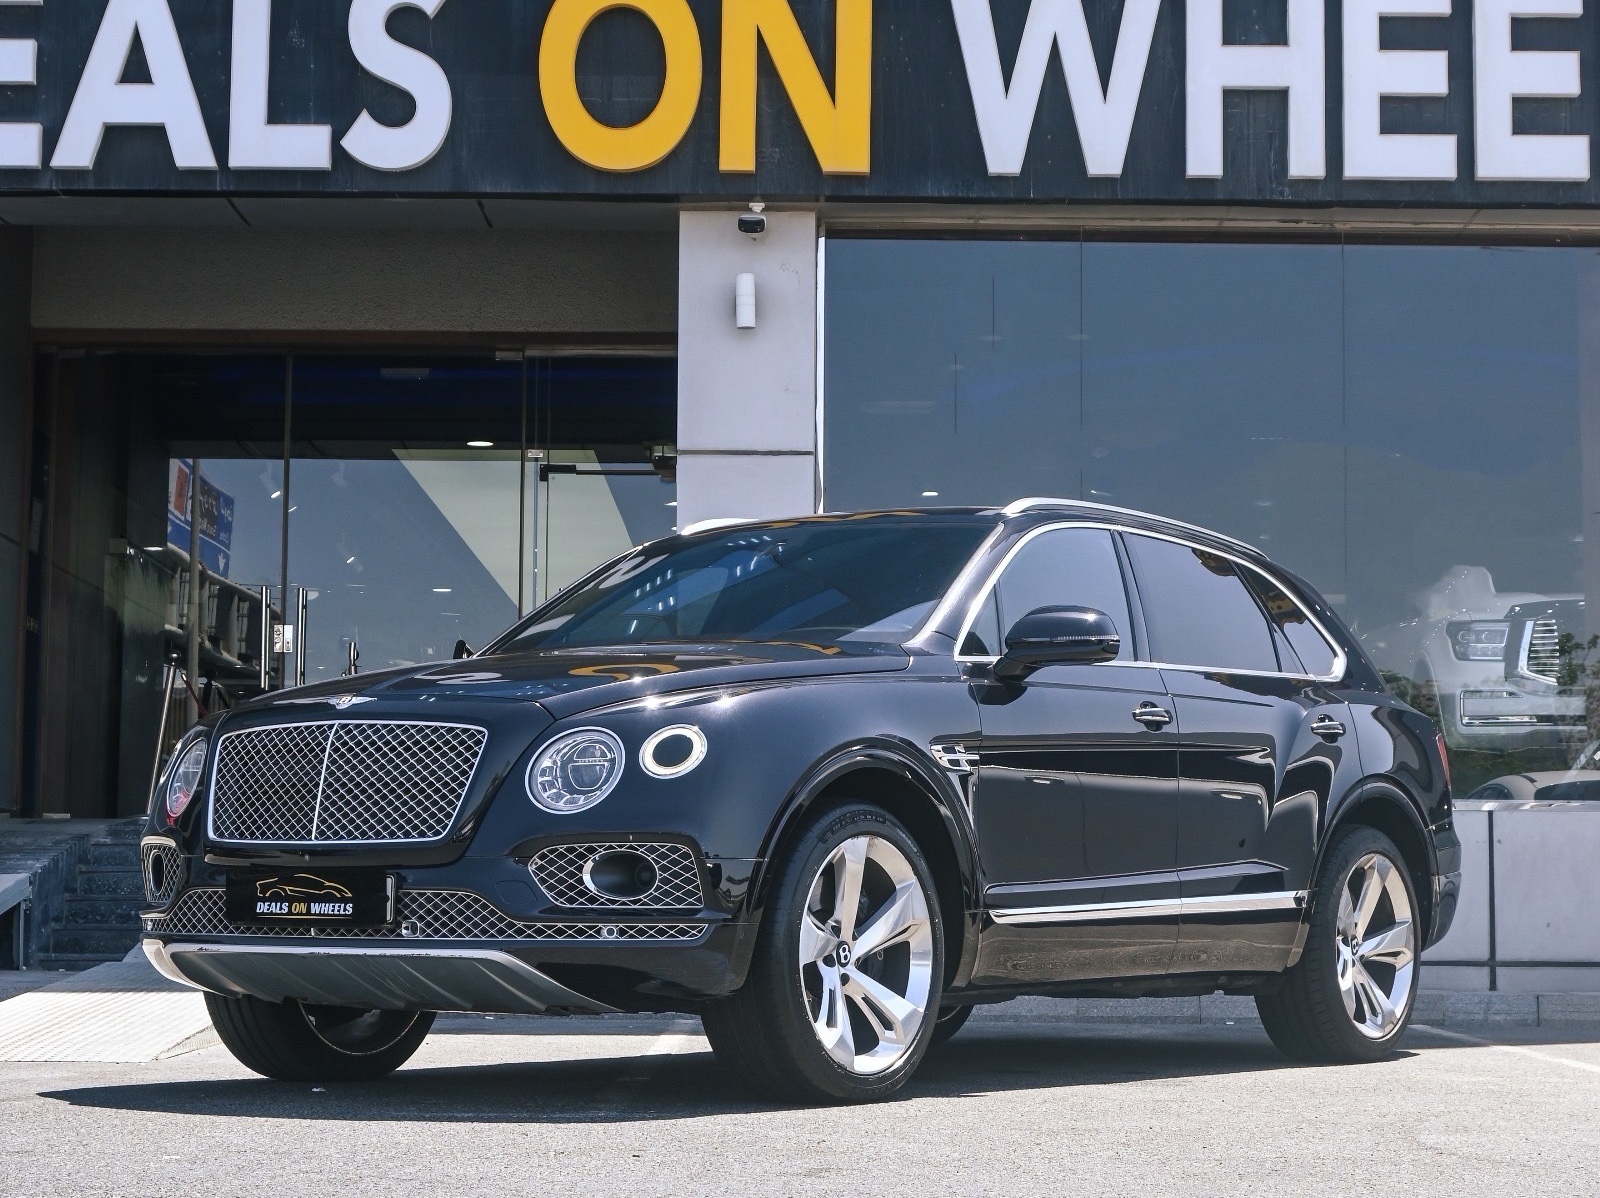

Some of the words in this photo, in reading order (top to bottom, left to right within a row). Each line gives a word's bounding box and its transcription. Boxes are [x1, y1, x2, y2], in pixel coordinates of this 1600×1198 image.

[538, 0, 872, 175] ON
[951, 0, 1591, 182] WHEE
[256, 902, 289, 914] DEALS
[291, 902, 308, 914] ON
[310, 902, 353, 915] WHEELS
